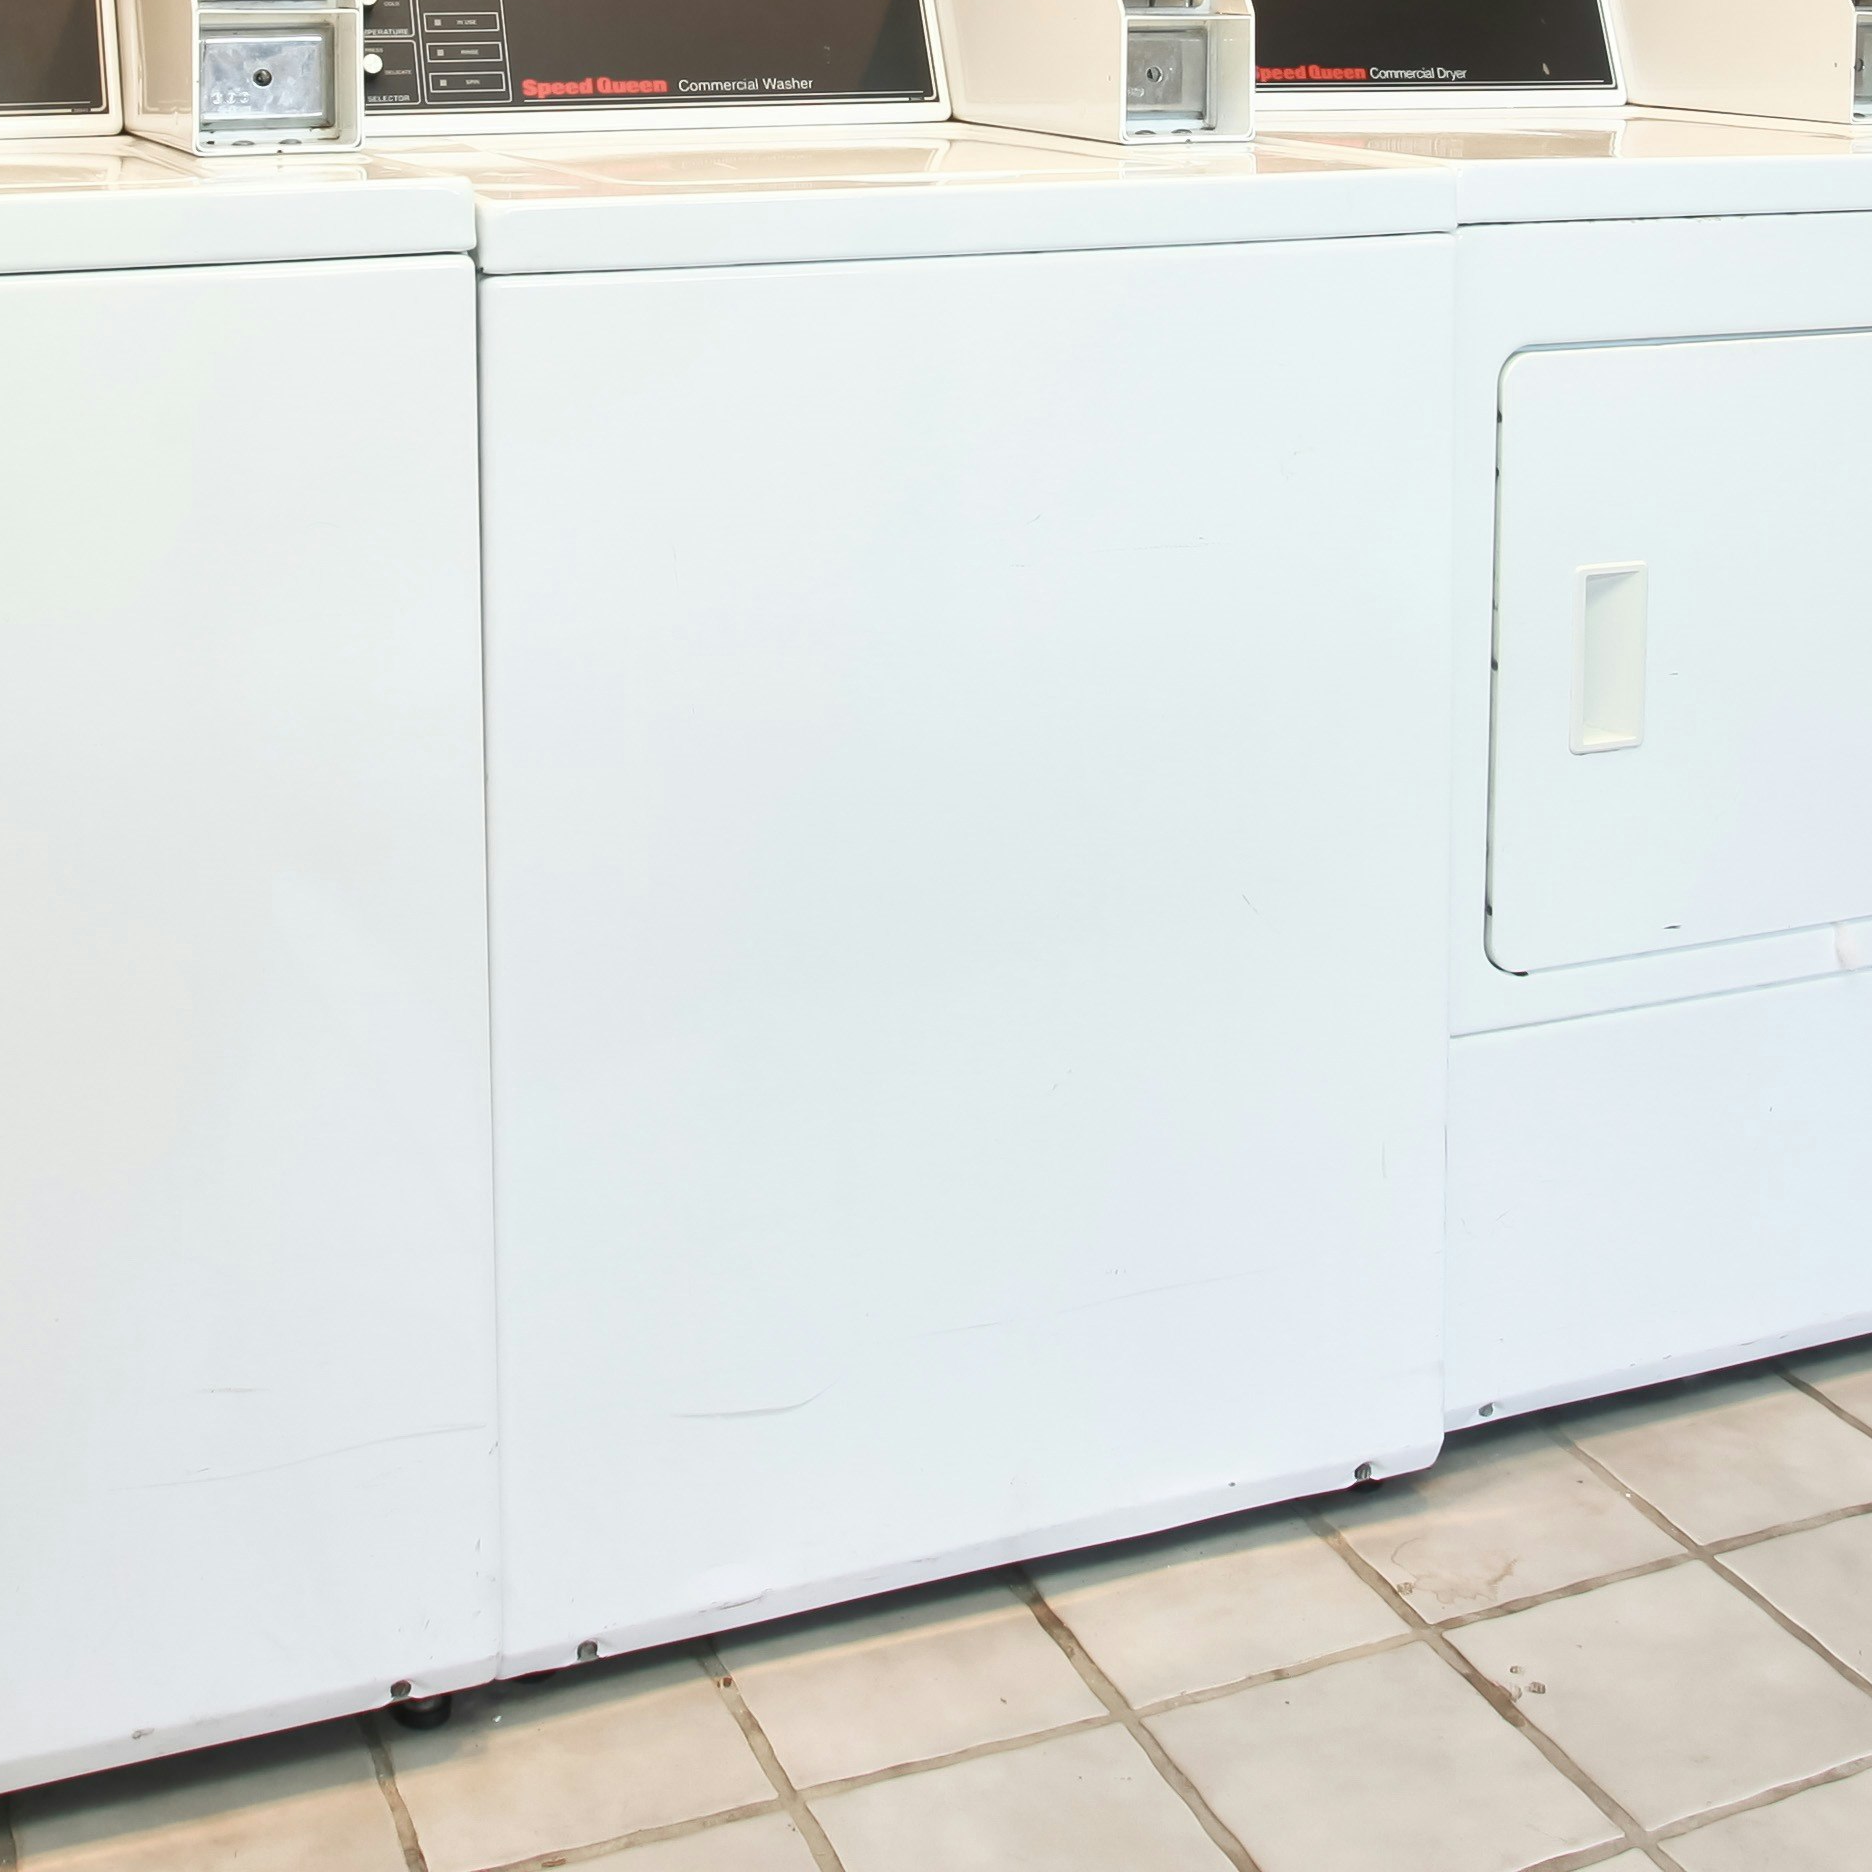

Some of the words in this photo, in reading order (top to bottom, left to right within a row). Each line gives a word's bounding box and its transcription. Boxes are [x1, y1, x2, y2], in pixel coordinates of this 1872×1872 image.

[1308, 64, 1367, 80] Queen
[1370, 67, 1434, 79] Commercial
[1437, 67, 1467, 81] Dryer
[522, 78, 593, 98] Speed
[597, 77, 668, 94] Queen
[679, 78, 758, 92] Commercial
[762, 77, 814, 90] Washer
[367, 95, 410, 103] SELECTOR
